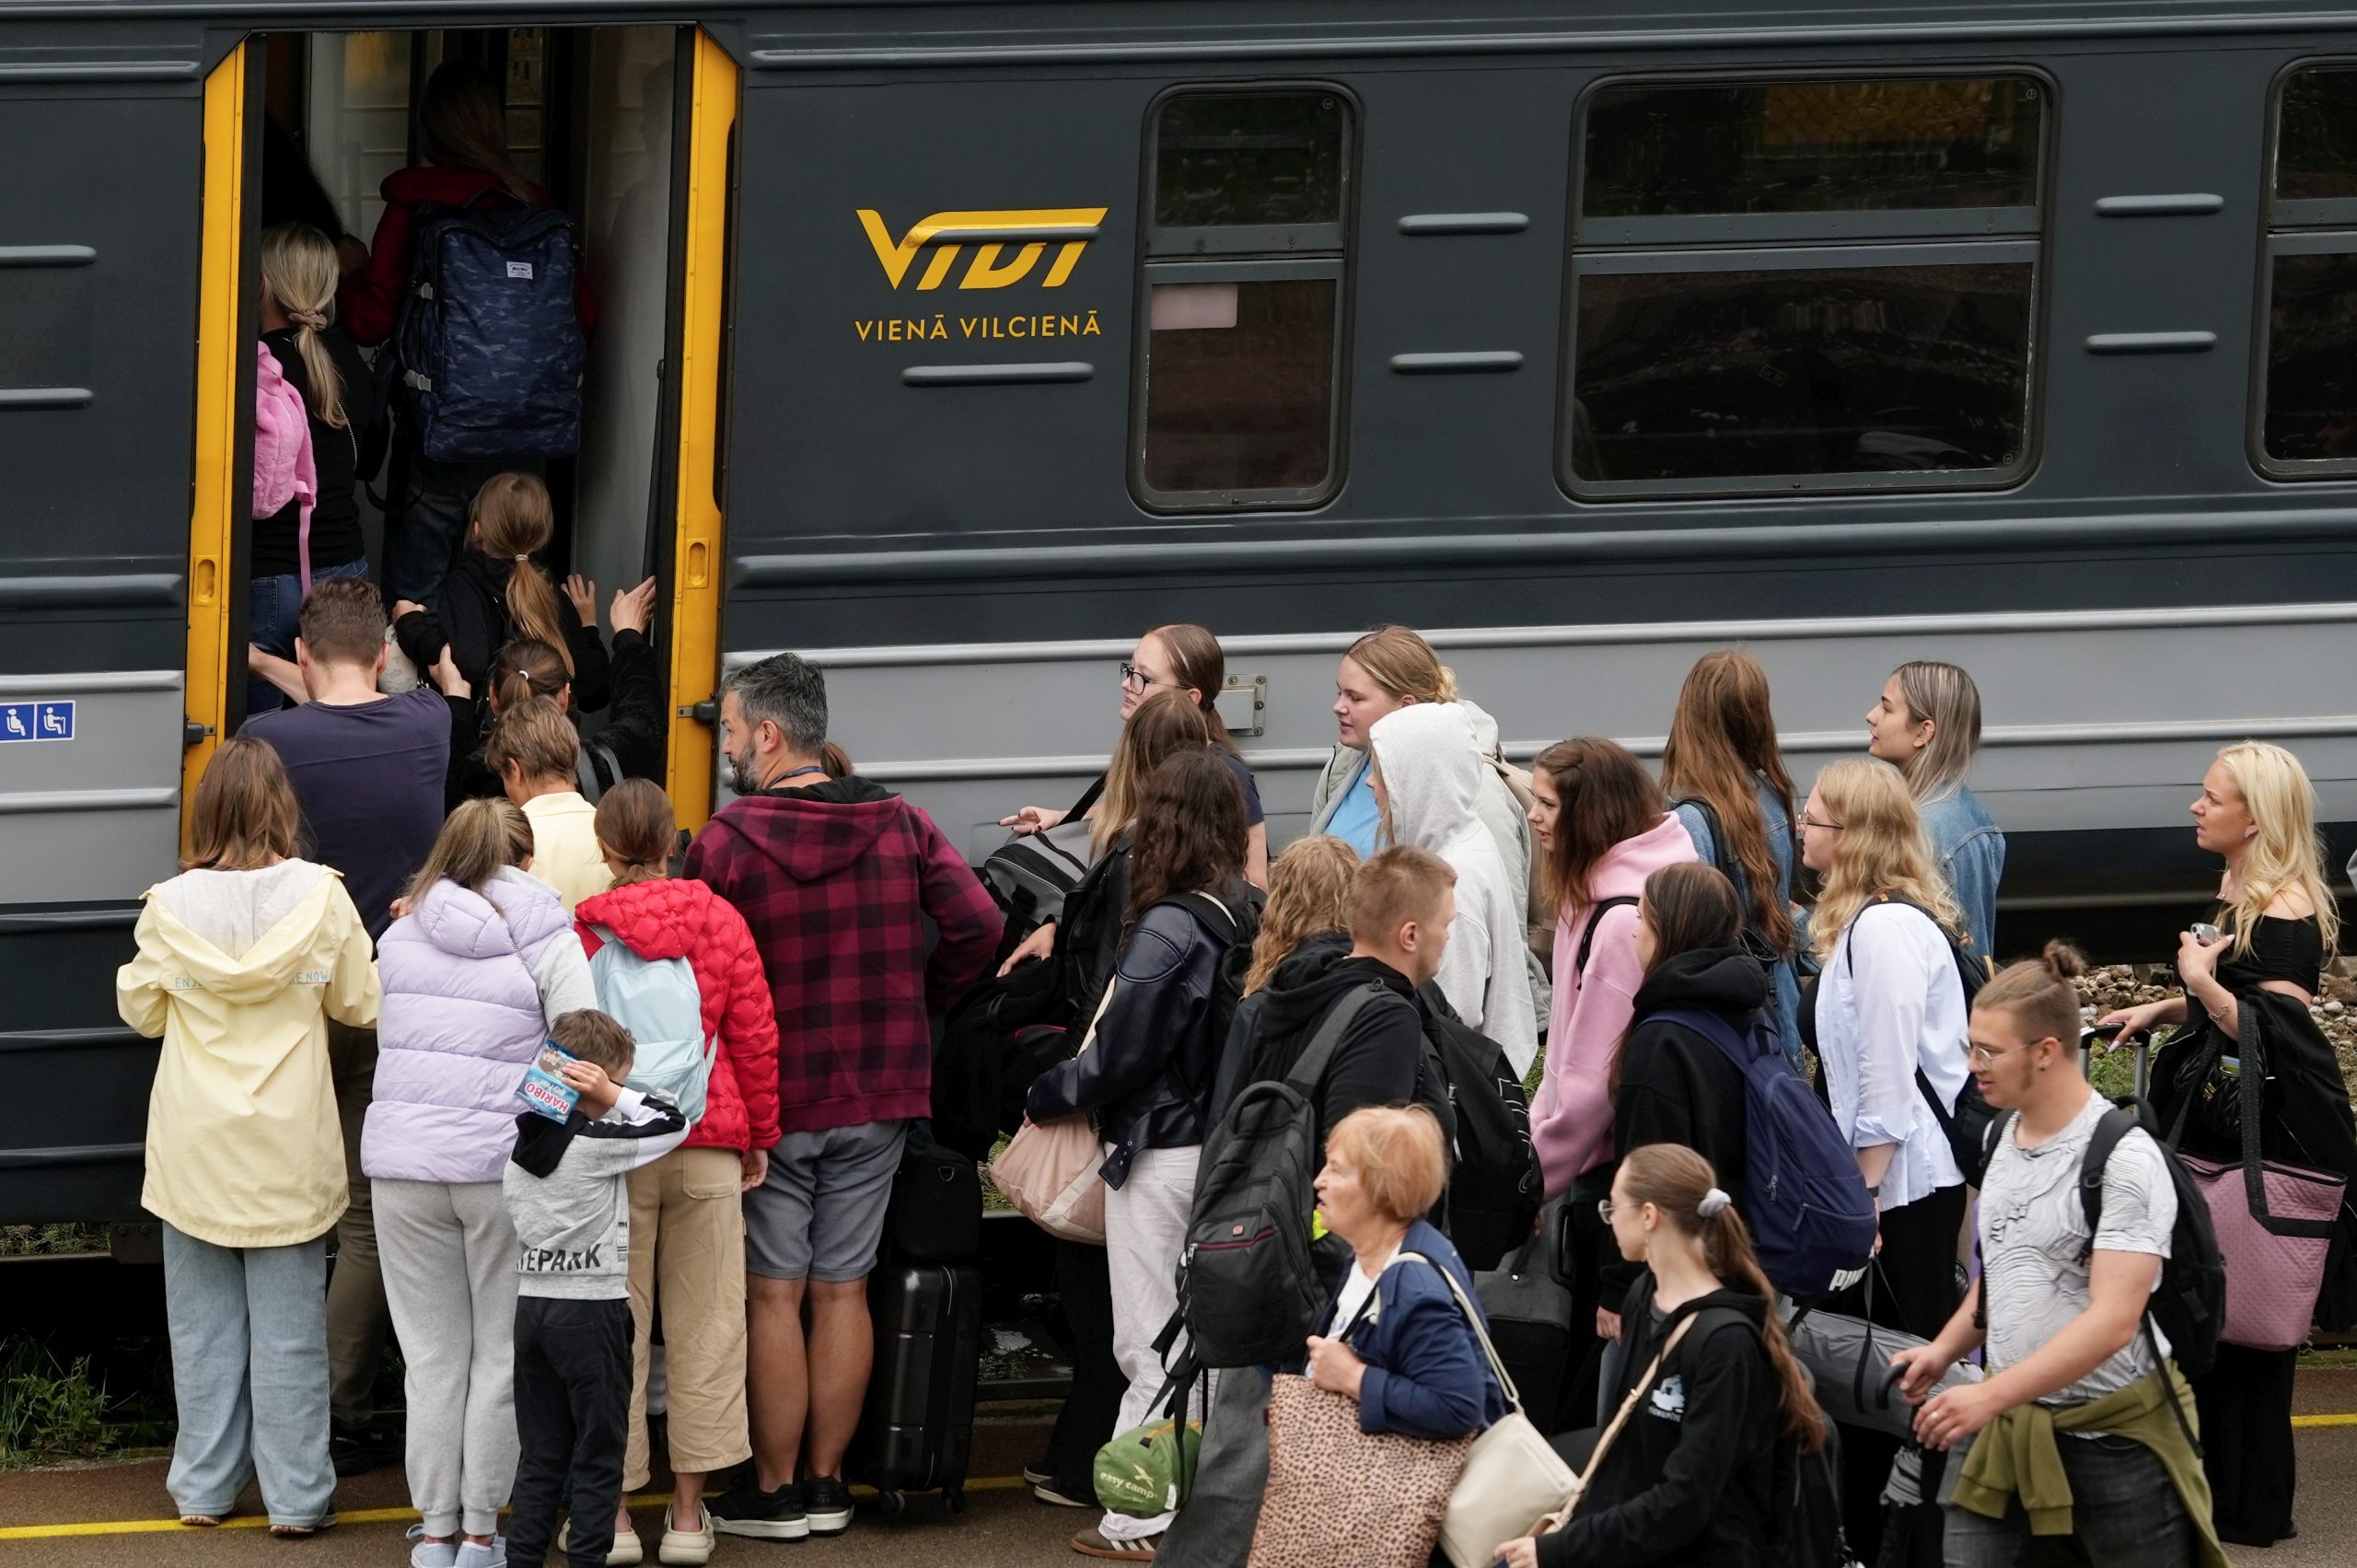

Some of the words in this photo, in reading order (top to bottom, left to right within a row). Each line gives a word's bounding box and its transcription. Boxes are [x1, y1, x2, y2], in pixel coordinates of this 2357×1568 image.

[854, 314, 948, 342] VIENĀ
[959, 310, 1101, 339] VILCIENĀ
[175, 977, 203, 988] ENJ
[306, 970, 328, 982] NOW
[526, 1083, 569, 1113] HARIBO
[517, 1243, 601, 1272] EPARK
[1100, 1472, 1123, 1488] easy
[1125, 1481, 1155, 1499] camp
